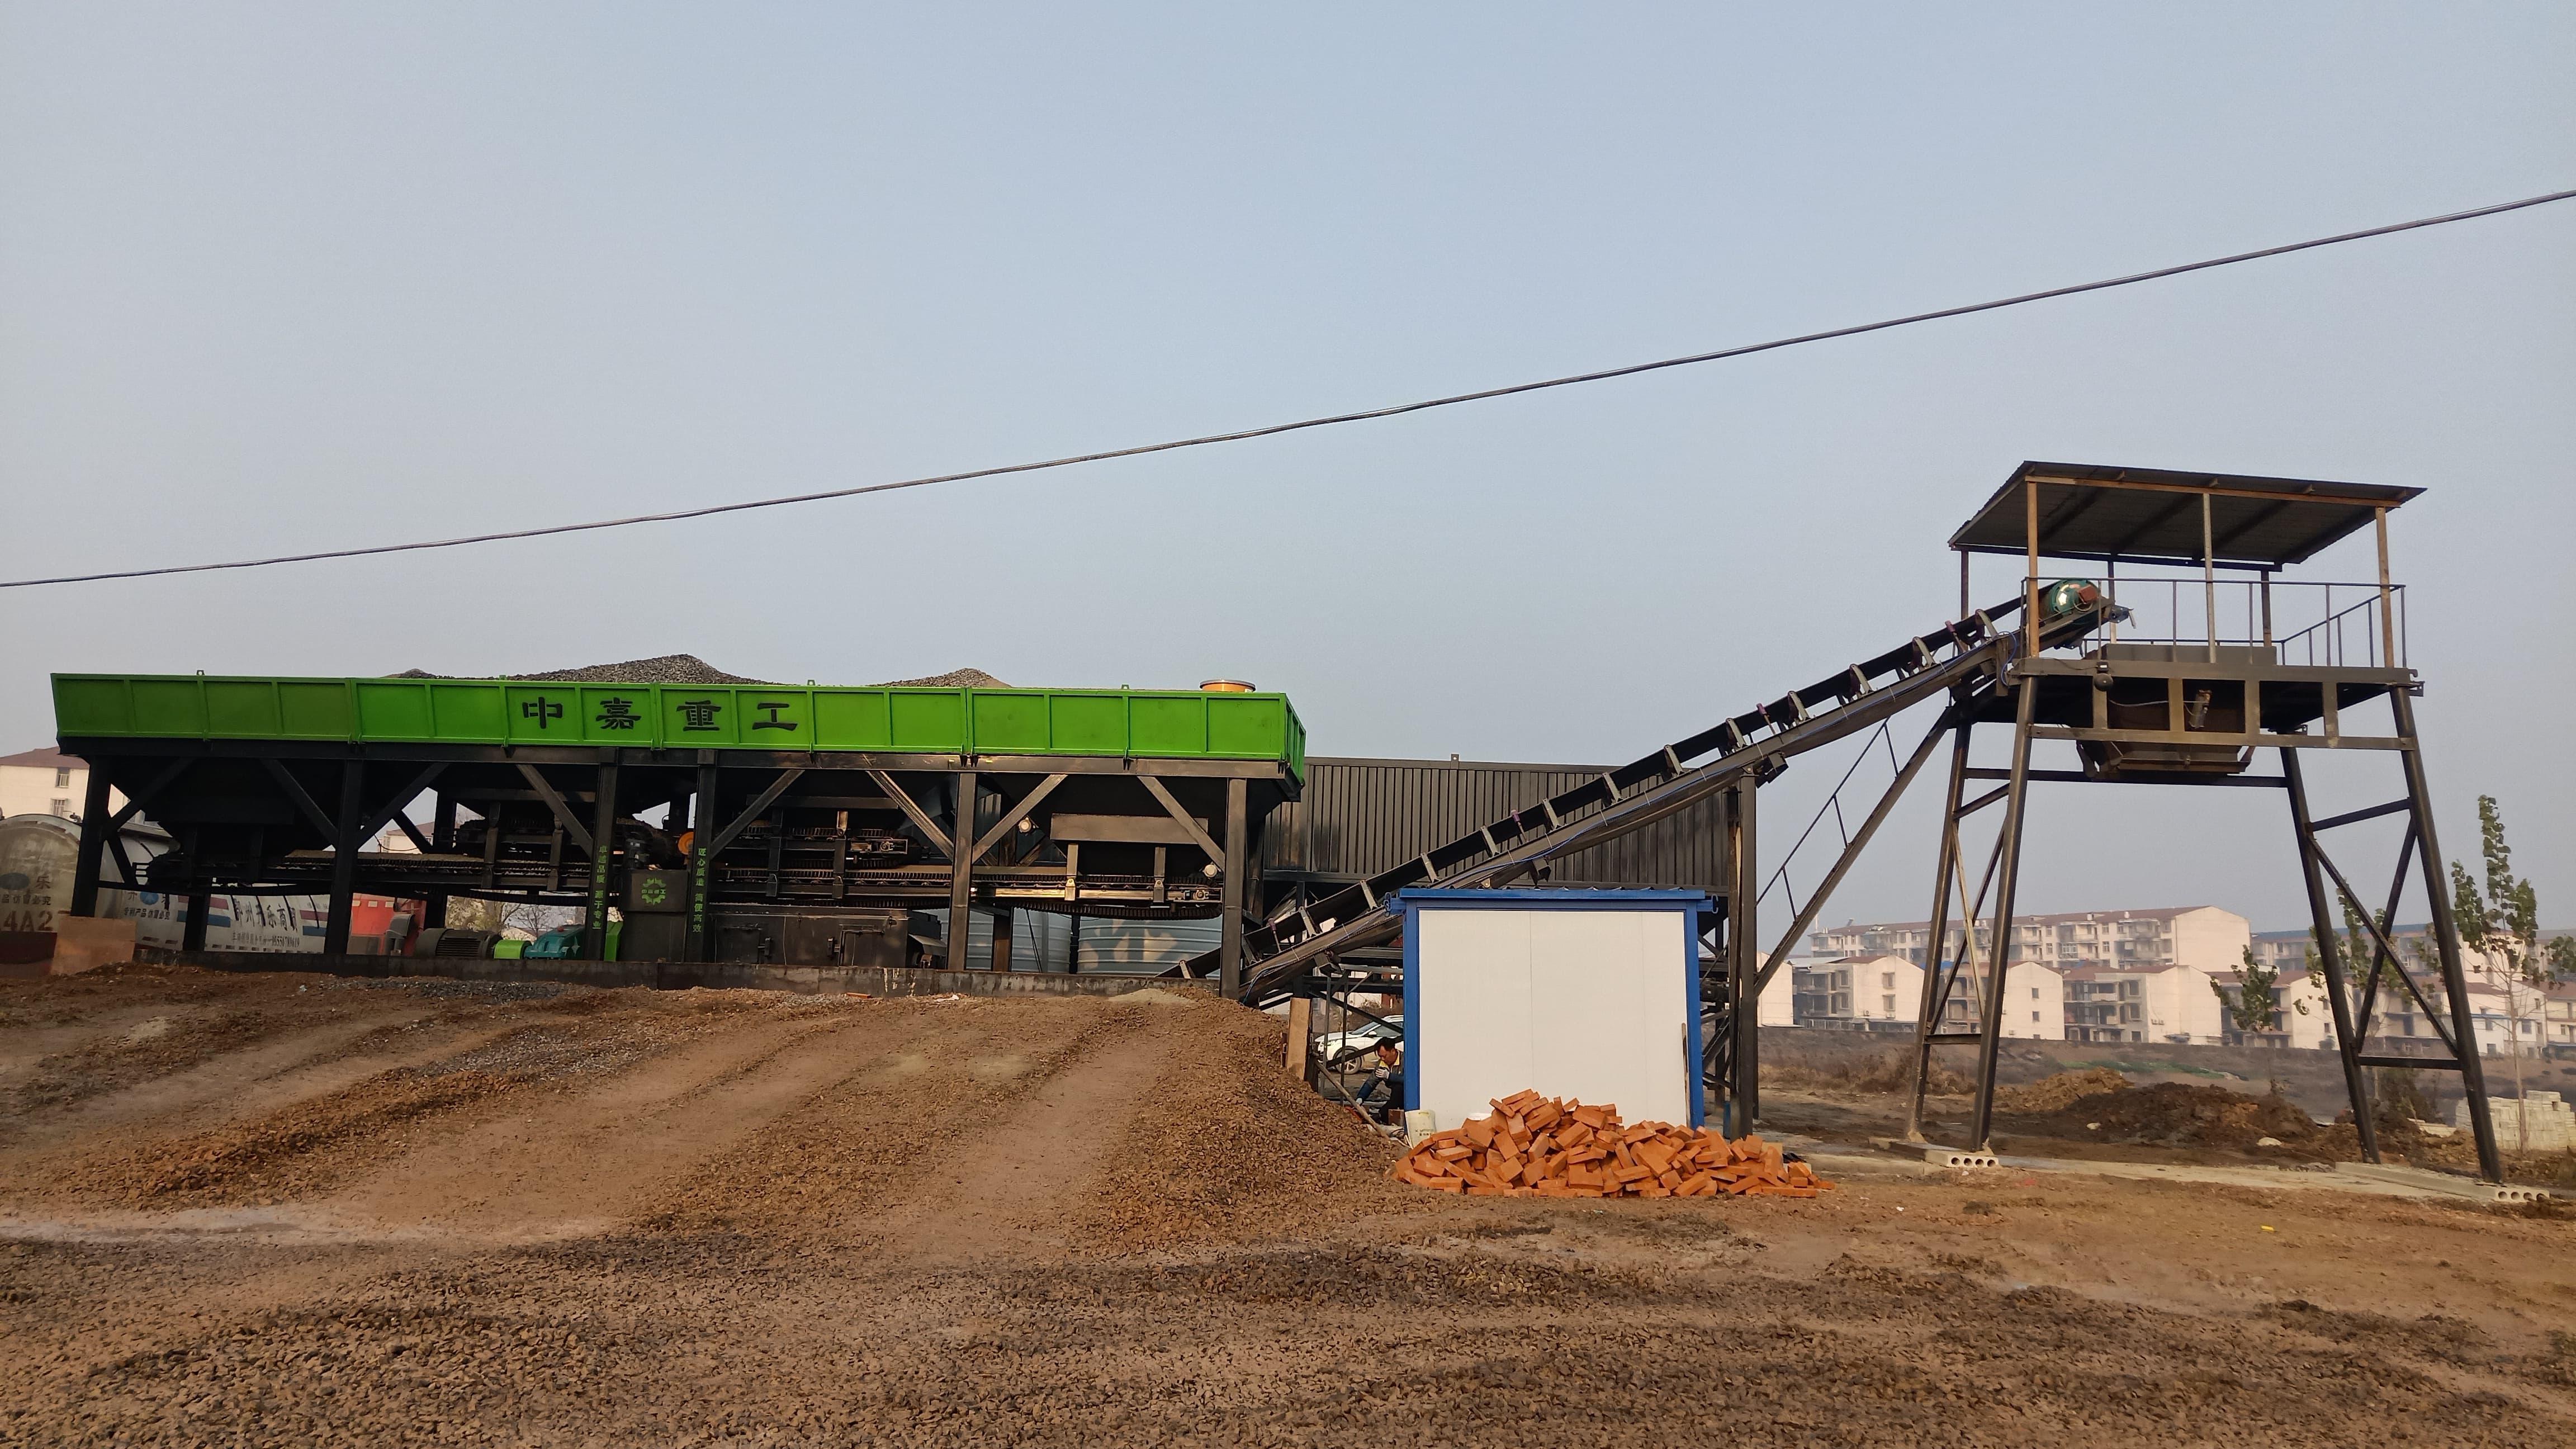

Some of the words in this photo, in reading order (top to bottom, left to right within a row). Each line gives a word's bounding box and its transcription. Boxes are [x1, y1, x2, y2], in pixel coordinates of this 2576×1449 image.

[522, 696, 798, 731] 中嘉重工
[596, 845, 608, 884] 卓越品质
[592, 890, 604, 930] 源于专业
